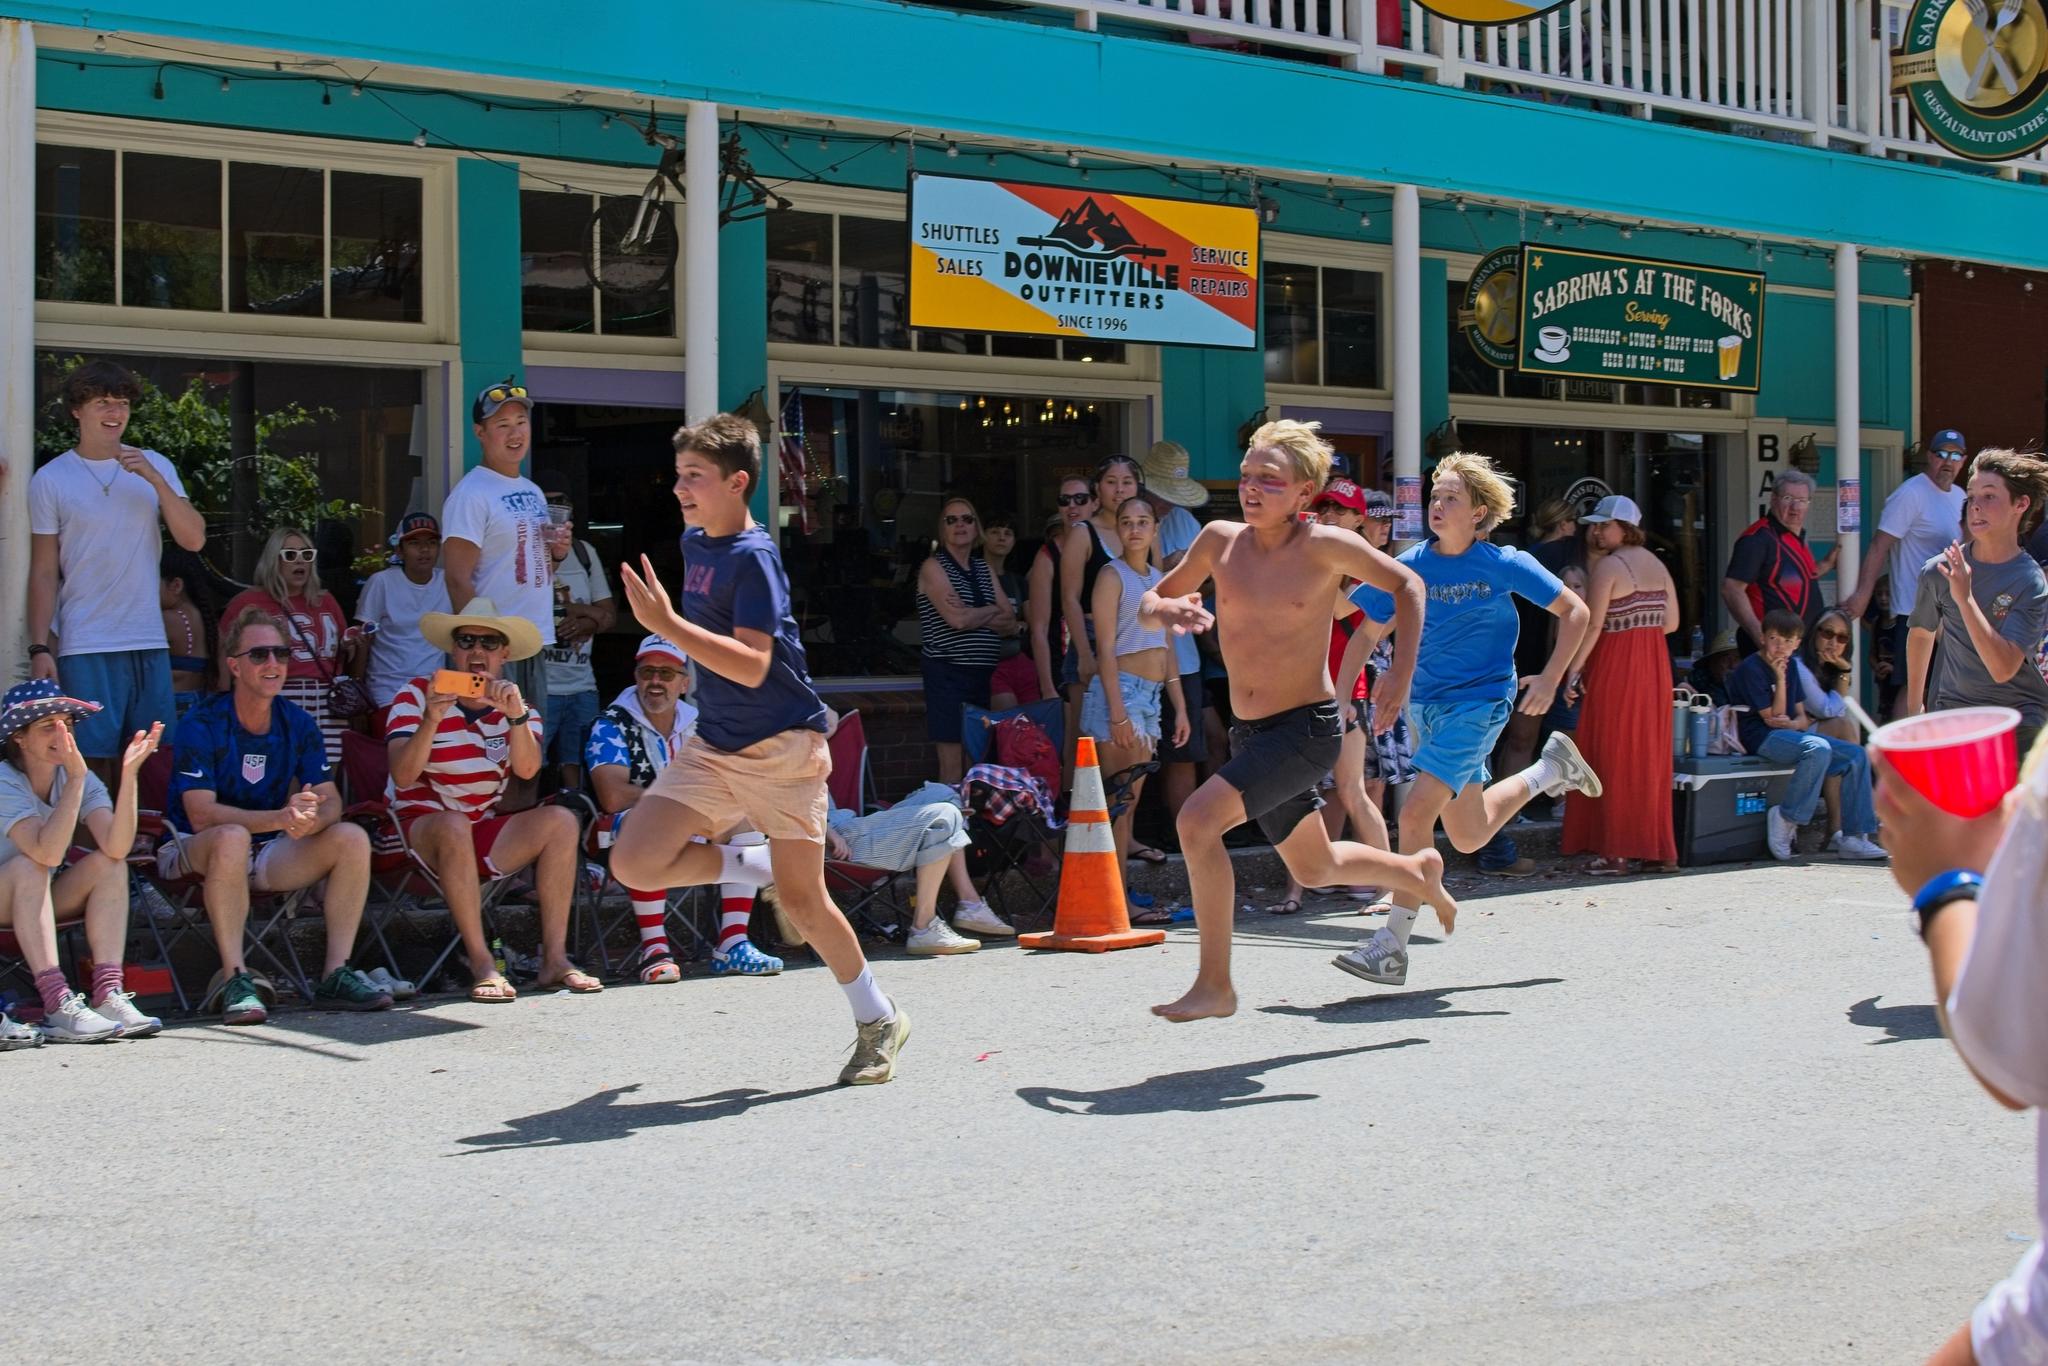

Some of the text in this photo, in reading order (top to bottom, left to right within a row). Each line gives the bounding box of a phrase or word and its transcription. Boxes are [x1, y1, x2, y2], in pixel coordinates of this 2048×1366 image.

[1922, 89, 2048, 143] RESTAURANT ON THE
[921, 222, 1000, 245] SHUTTLES
[936, 257, 983, 276] SALES
[1192, 246, 1249, 267] SERVICE
[1004, 251, 1179, 291] DOWNIEVILLE
[1020, 283, 1164, 310] OUTFITTERS
[1189, 276, 1249, 298] REPAIRS
[1532, 268, 1752, 339] SABRINA'S AT THE FORKS
[1625, 301, 1671, 331] Serving
[1058, 314, 1128, 332] SINCE 1996
[1572, 326, 1714, 354] BREAKFAST LUNCH HAPPY HOUR
[1602, 352, 1685, 374] BEER ON TAP WINE
[280, 611, 339, 662] SA
